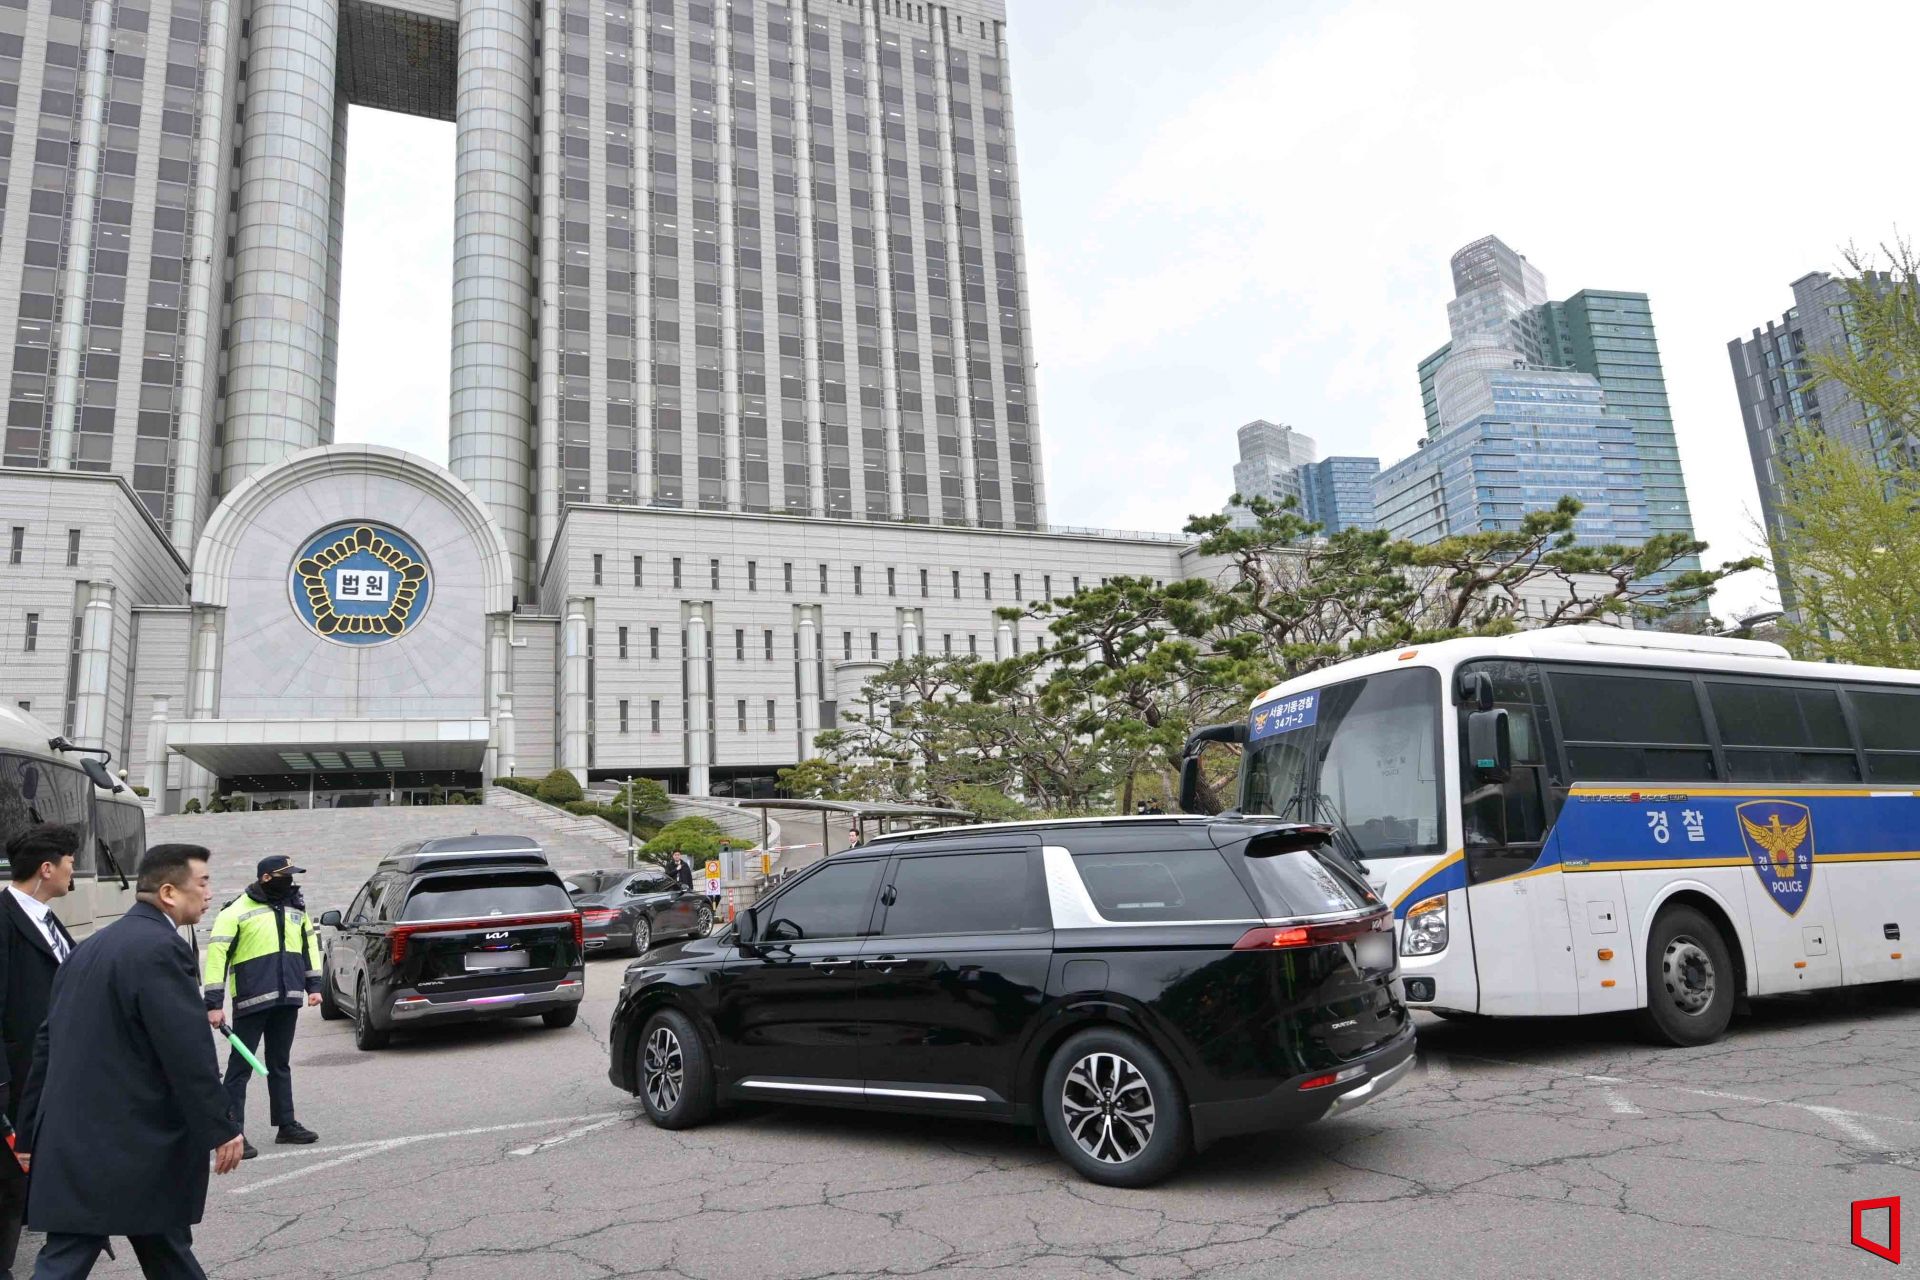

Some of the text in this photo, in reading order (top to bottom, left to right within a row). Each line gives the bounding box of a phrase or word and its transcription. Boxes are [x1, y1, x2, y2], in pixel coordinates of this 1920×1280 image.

[342, 575, 383, 596] 법원
[1269, 696, 1314, 718] 서울기동경찰
[1274, 713, 1304, 729] 34기-2
[1772, 881, 1803, 893] POLICE
